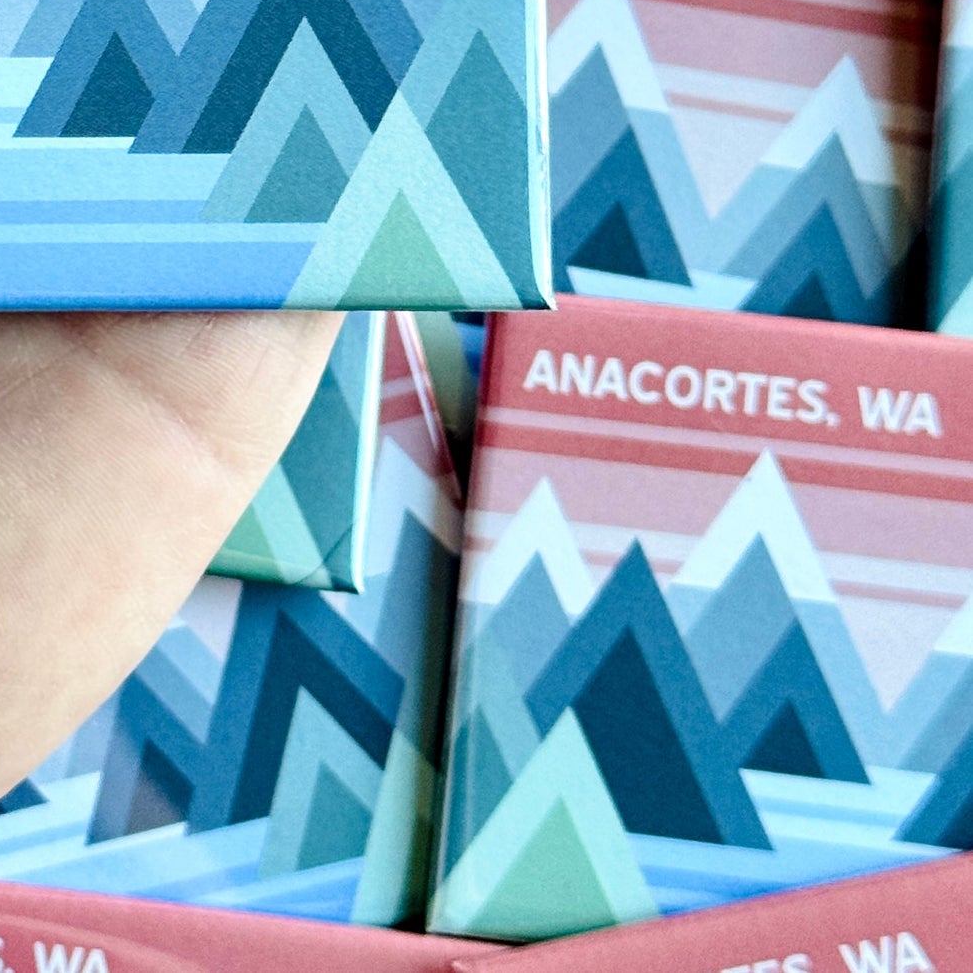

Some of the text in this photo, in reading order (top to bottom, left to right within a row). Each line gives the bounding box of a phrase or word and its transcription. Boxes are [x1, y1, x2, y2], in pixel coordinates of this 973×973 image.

[523, 349, 943, 439] ANACORTES, WA
[33, 940, 110, 973] WA
[838, 931, 937, 973] WA
